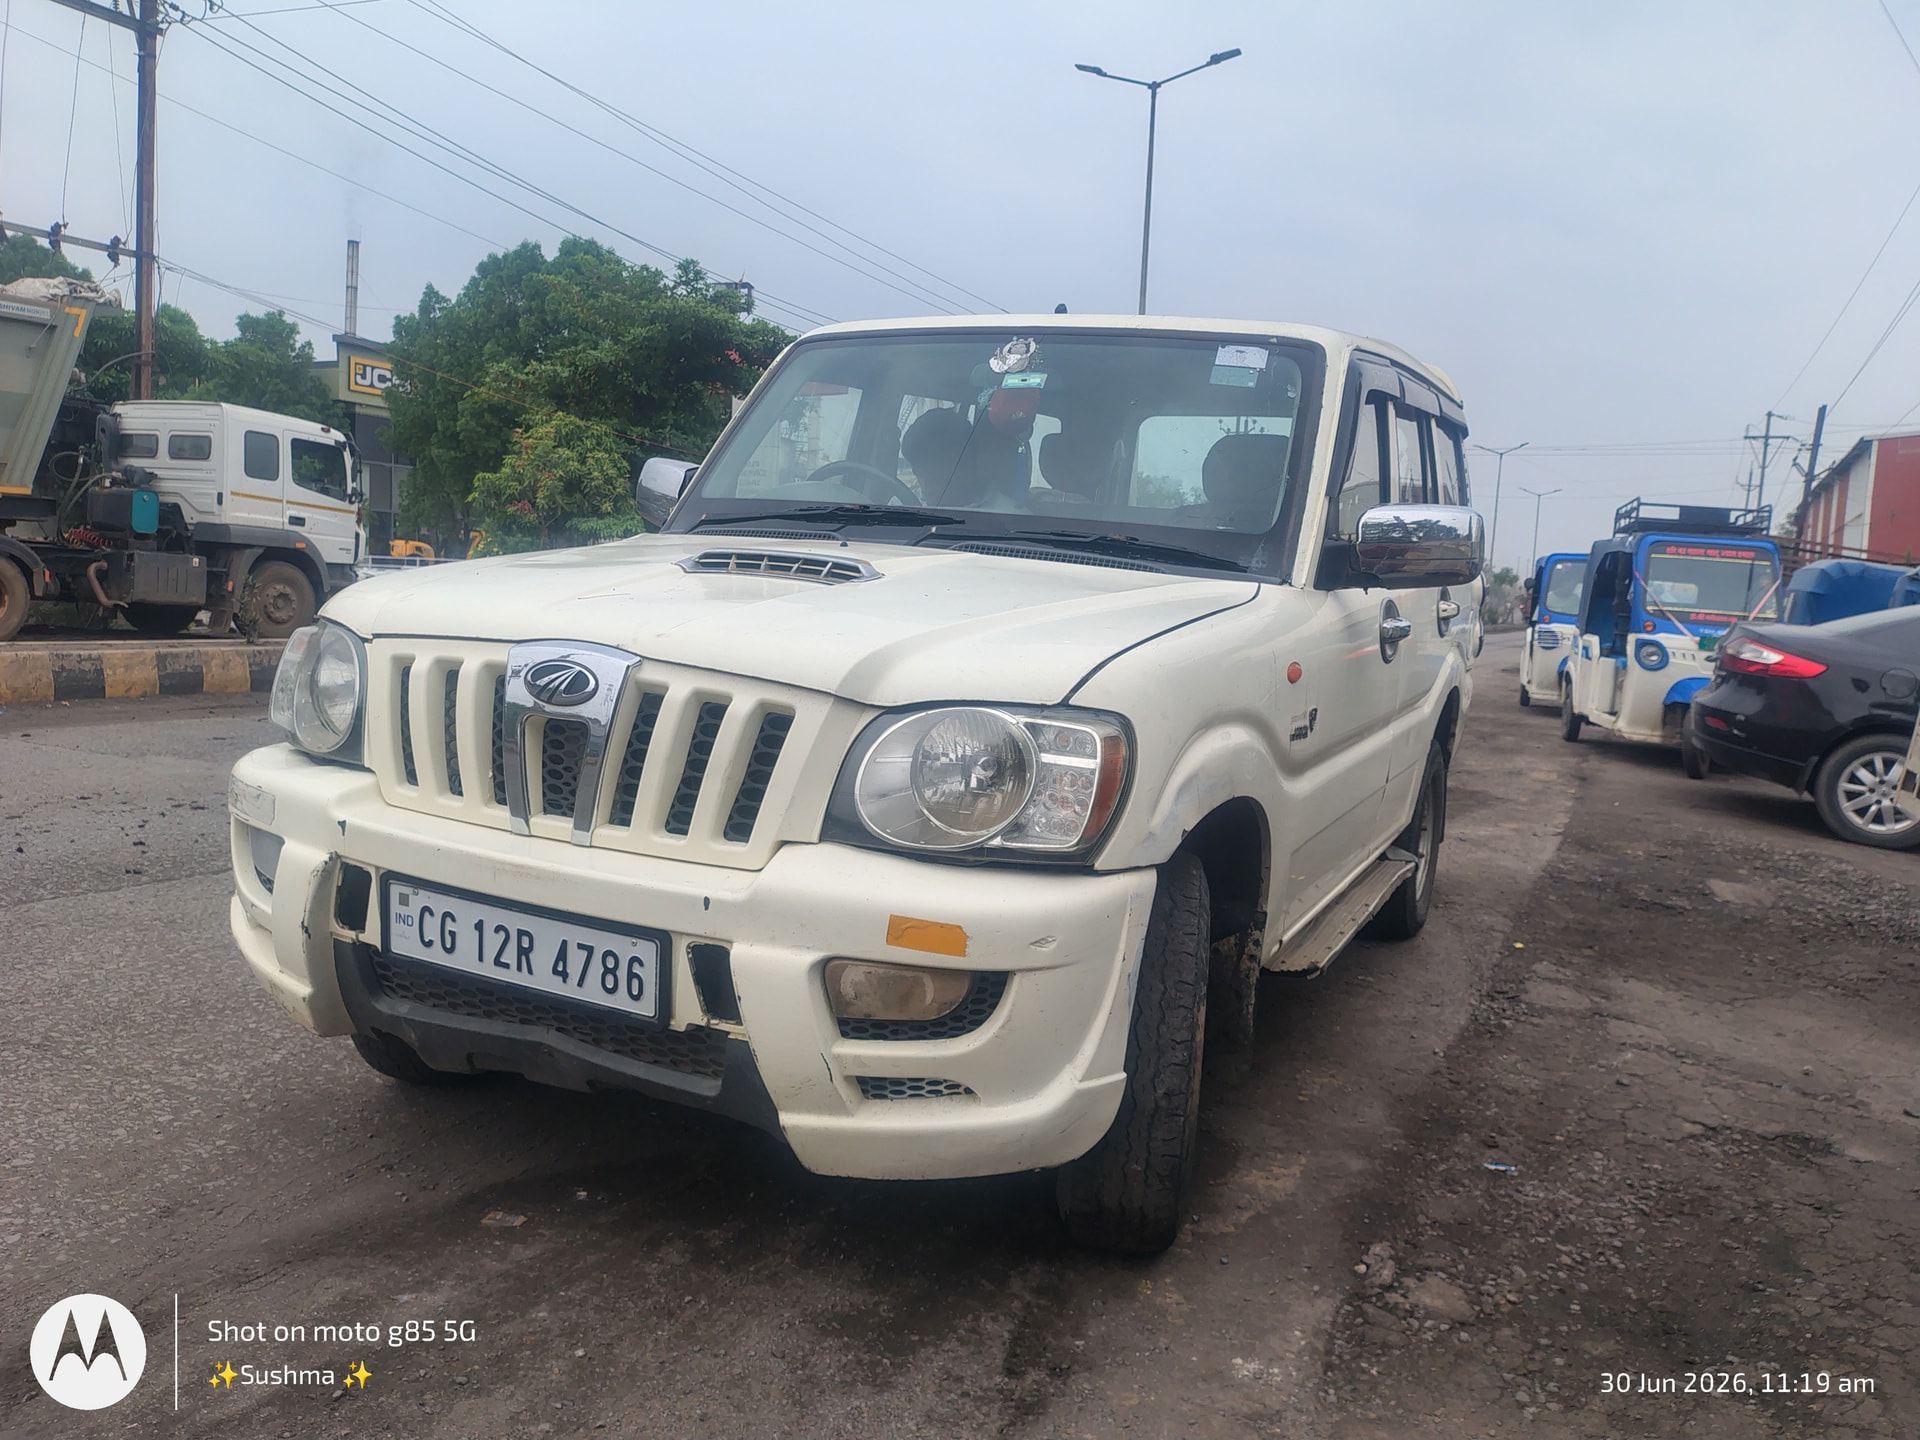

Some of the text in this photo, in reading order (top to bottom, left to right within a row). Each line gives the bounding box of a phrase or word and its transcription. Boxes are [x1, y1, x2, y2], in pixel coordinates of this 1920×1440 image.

[395, 911, 414, 928] IND
[418, 905, 644, 1001] CG 12R 4786
